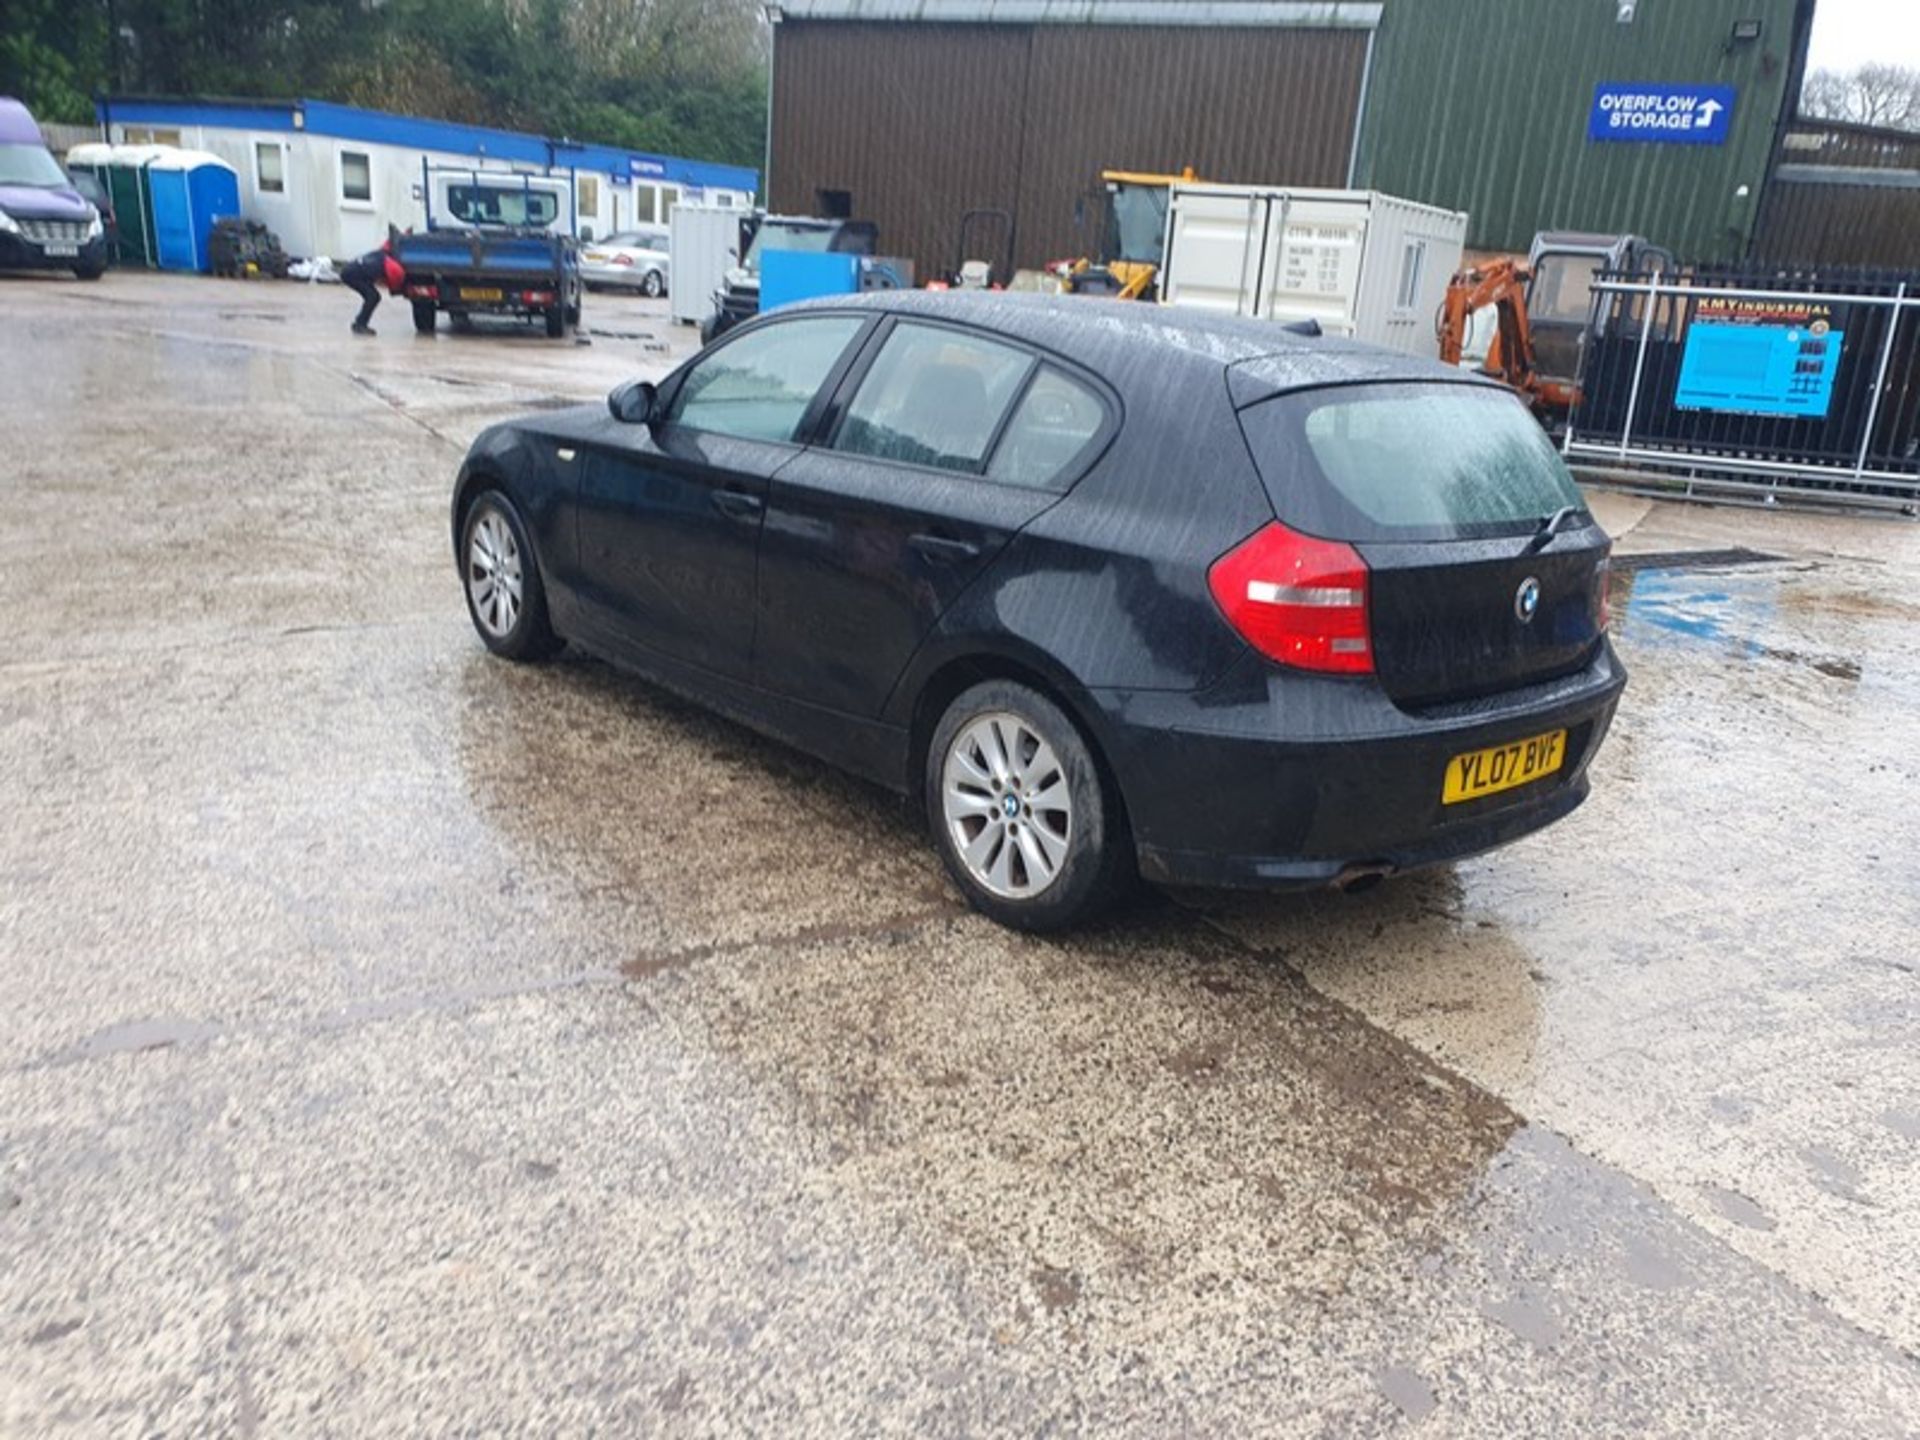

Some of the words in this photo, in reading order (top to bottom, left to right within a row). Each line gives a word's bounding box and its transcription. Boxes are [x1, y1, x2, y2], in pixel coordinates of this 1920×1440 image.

[1600, 93, 1697, 112] OVERFLOW
[1609, 112, 1693, 129] STORAGE
[1459, 745, 1522, 792] YL07
[1523, 732, 1561, 775] BVF
